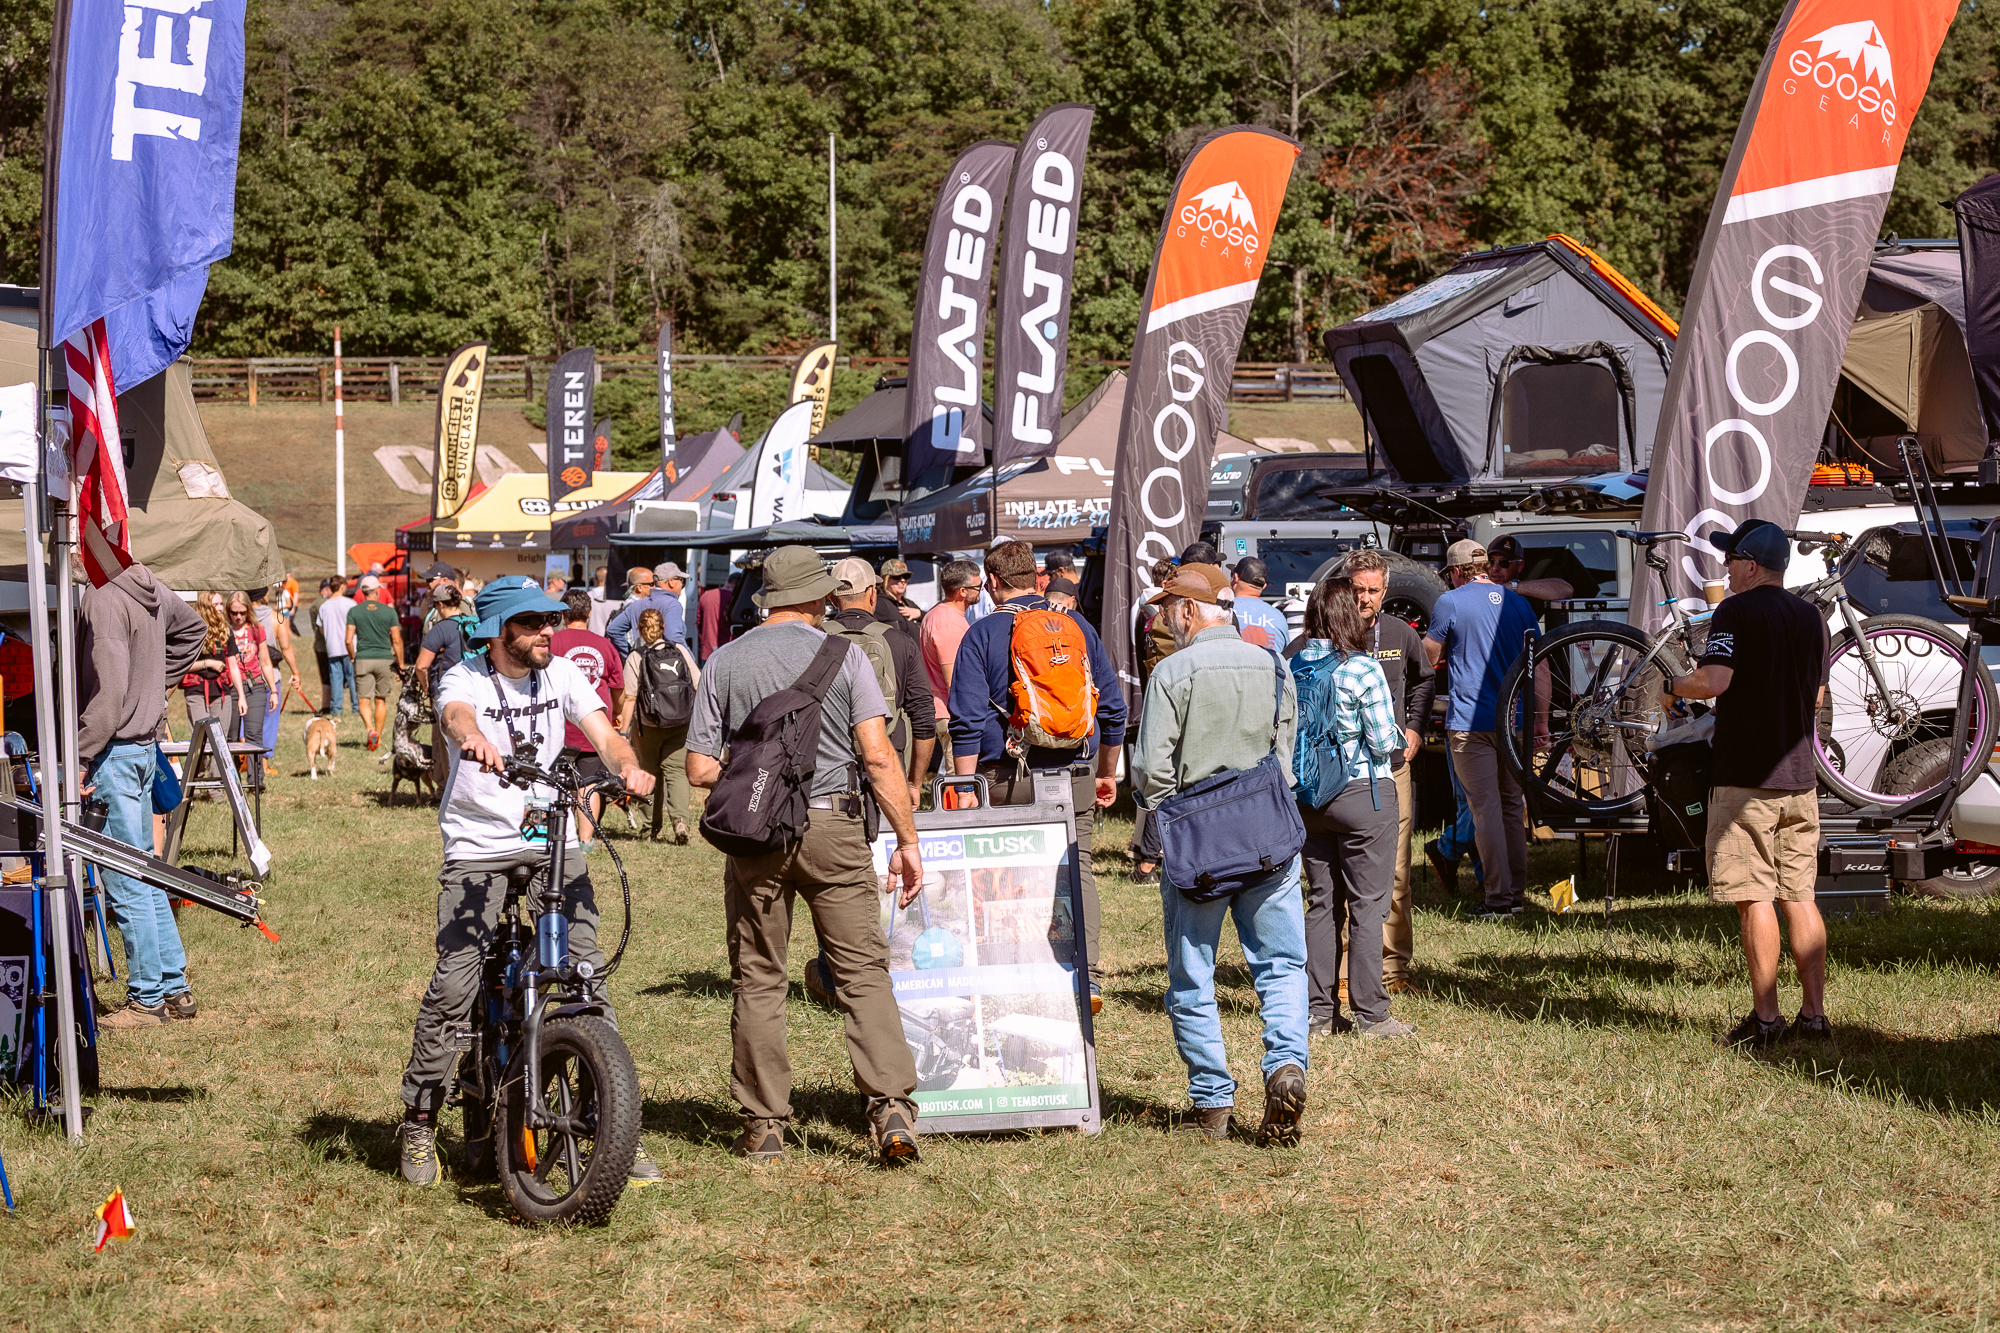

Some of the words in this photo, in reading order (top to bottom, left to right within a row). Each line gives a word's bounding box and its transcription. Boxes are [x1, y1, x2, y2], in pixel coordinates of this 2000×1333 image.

[1783, 78, 1892, 148] GEAR
[1176, 226, 1252, 270] GEAR
[1012, 151, 1075, 445] FLATED
[931, 184, 994, 453] FLATED
[456, 389, 476, 479] SUNGLASSES
[563, 371, 586, 464] TEREN
[1211, 471, 1243, 481] FLATED
[965, 512, 986, 529] FLATED
[1232, 608, 1276, 629] Huk
[887, 838, 964, 860] TMBO
[973, 834, 1036, 855] TUSK
[895, 977, 943, 992] AMERICAN
[948, 973, 976, 988] MADE
[917, 1099, 984, 1113] MBOTUSK.COM
[1011, 1094, 1068, 1108] TEMBOTUSK
